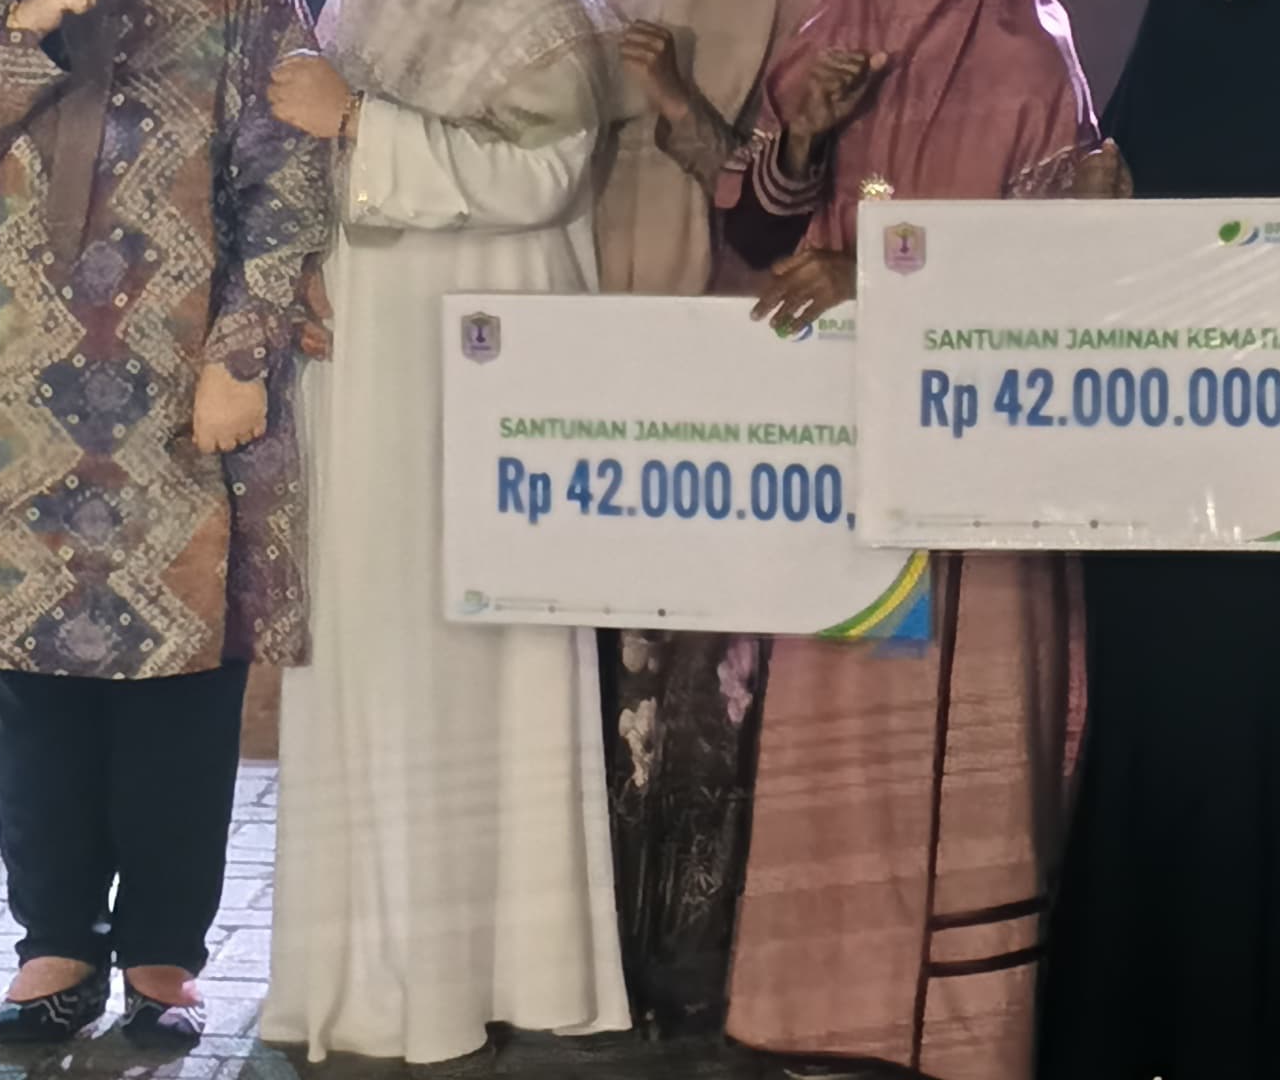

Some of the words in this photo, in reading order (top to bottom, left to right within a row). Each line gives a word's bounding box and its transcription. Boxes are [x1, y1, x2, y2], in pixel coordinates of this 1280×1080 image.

[924, 329, 1059, 351] SANTUNAN
[1066, 329, 1180, 350] JAMINAN
[920, 368, 978, 439] Rp
[499, 417, 627, 441] SANTUNAN
[633, 421, 741, 444] JAMINAN
[747, 424, 857, 446] KEMATIA
[498, 456, 551, 526] Rp
